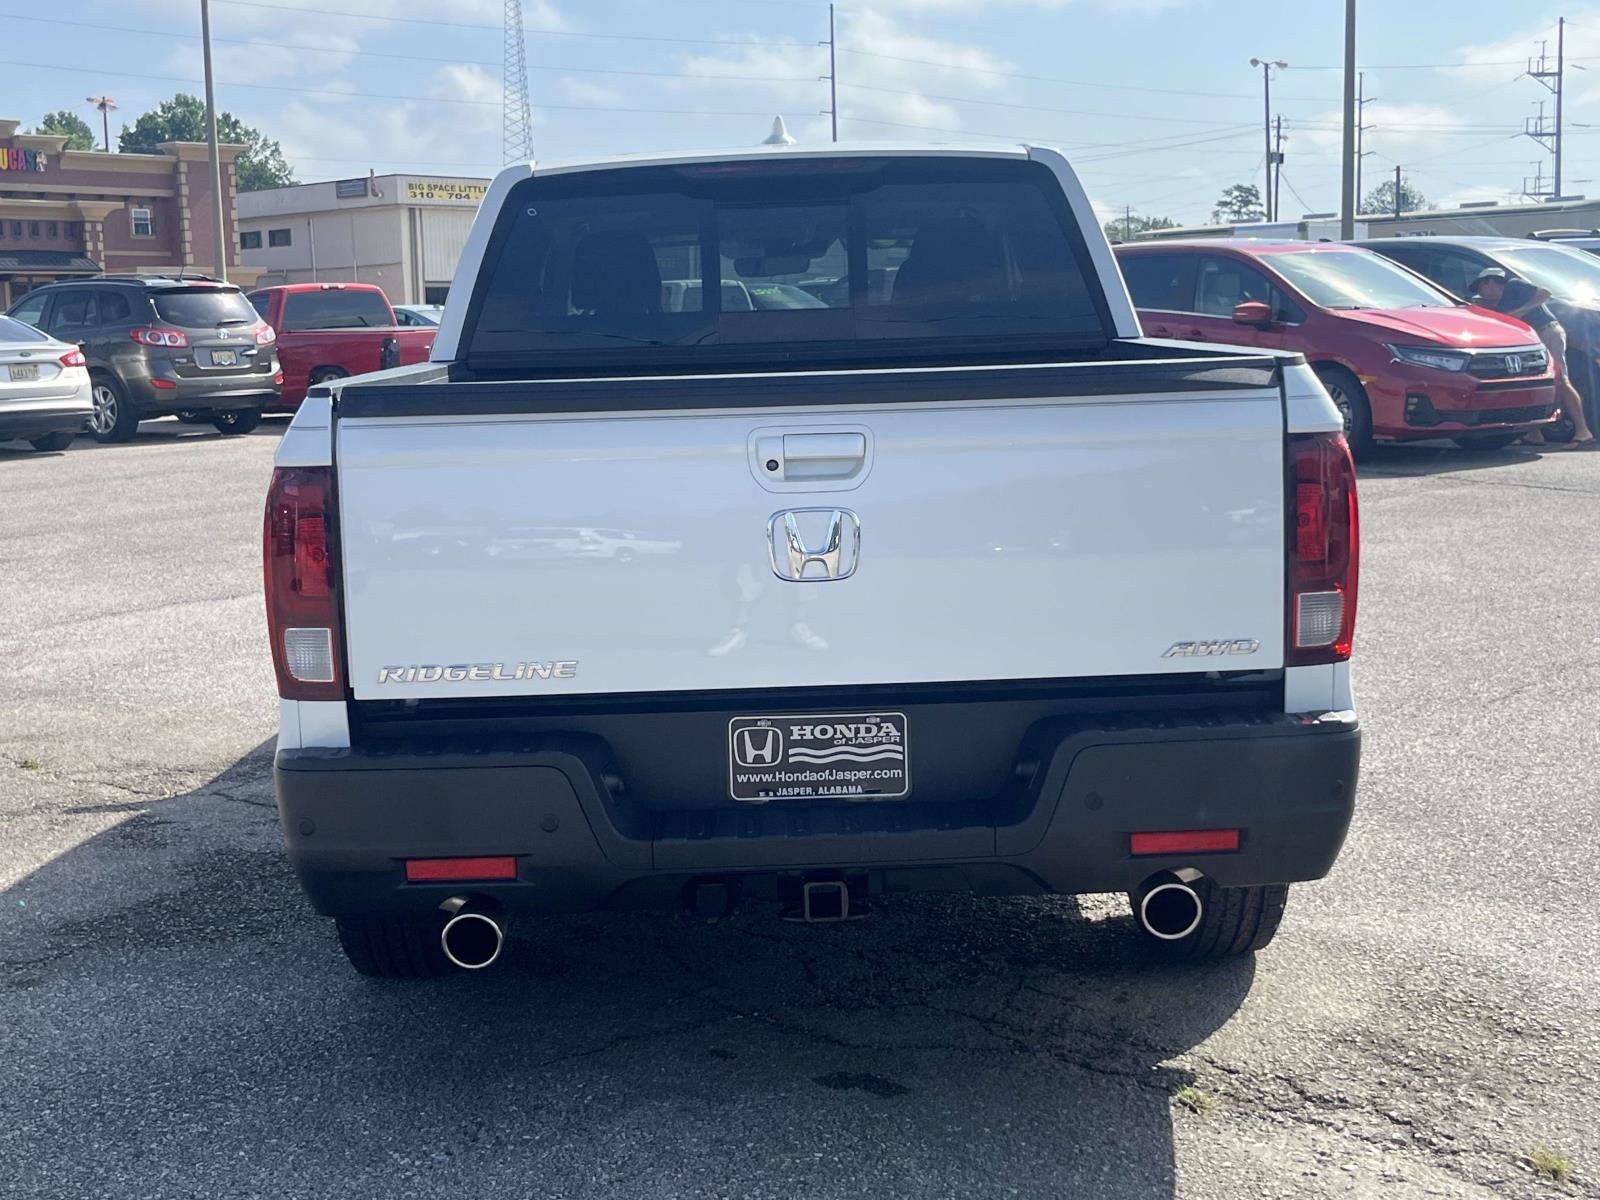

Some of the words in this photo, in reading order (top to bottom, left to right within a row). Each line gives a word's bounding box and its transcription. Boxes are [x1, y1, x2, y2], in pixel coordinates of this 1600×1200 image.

[408, 182, 425, 191] BIG
[427, 183, 457, 192] SPACE
[409, 190, 434, 199] 310
[447, 192, 471, 200] 704
[1160, 637, 1261, 658] AWD
[377, 659, 579, 684] RIDGELINE
[789, 722, 901, 740] HONDA
[833, 737, 847, 745] of
[848, 736, 900, 745] JASPER
[736, 768, 902, 783] www.HondaofJasper.com
[776, 786, 815, 797] JASPER,
[817, 785, 863, 796] ALABAMA
